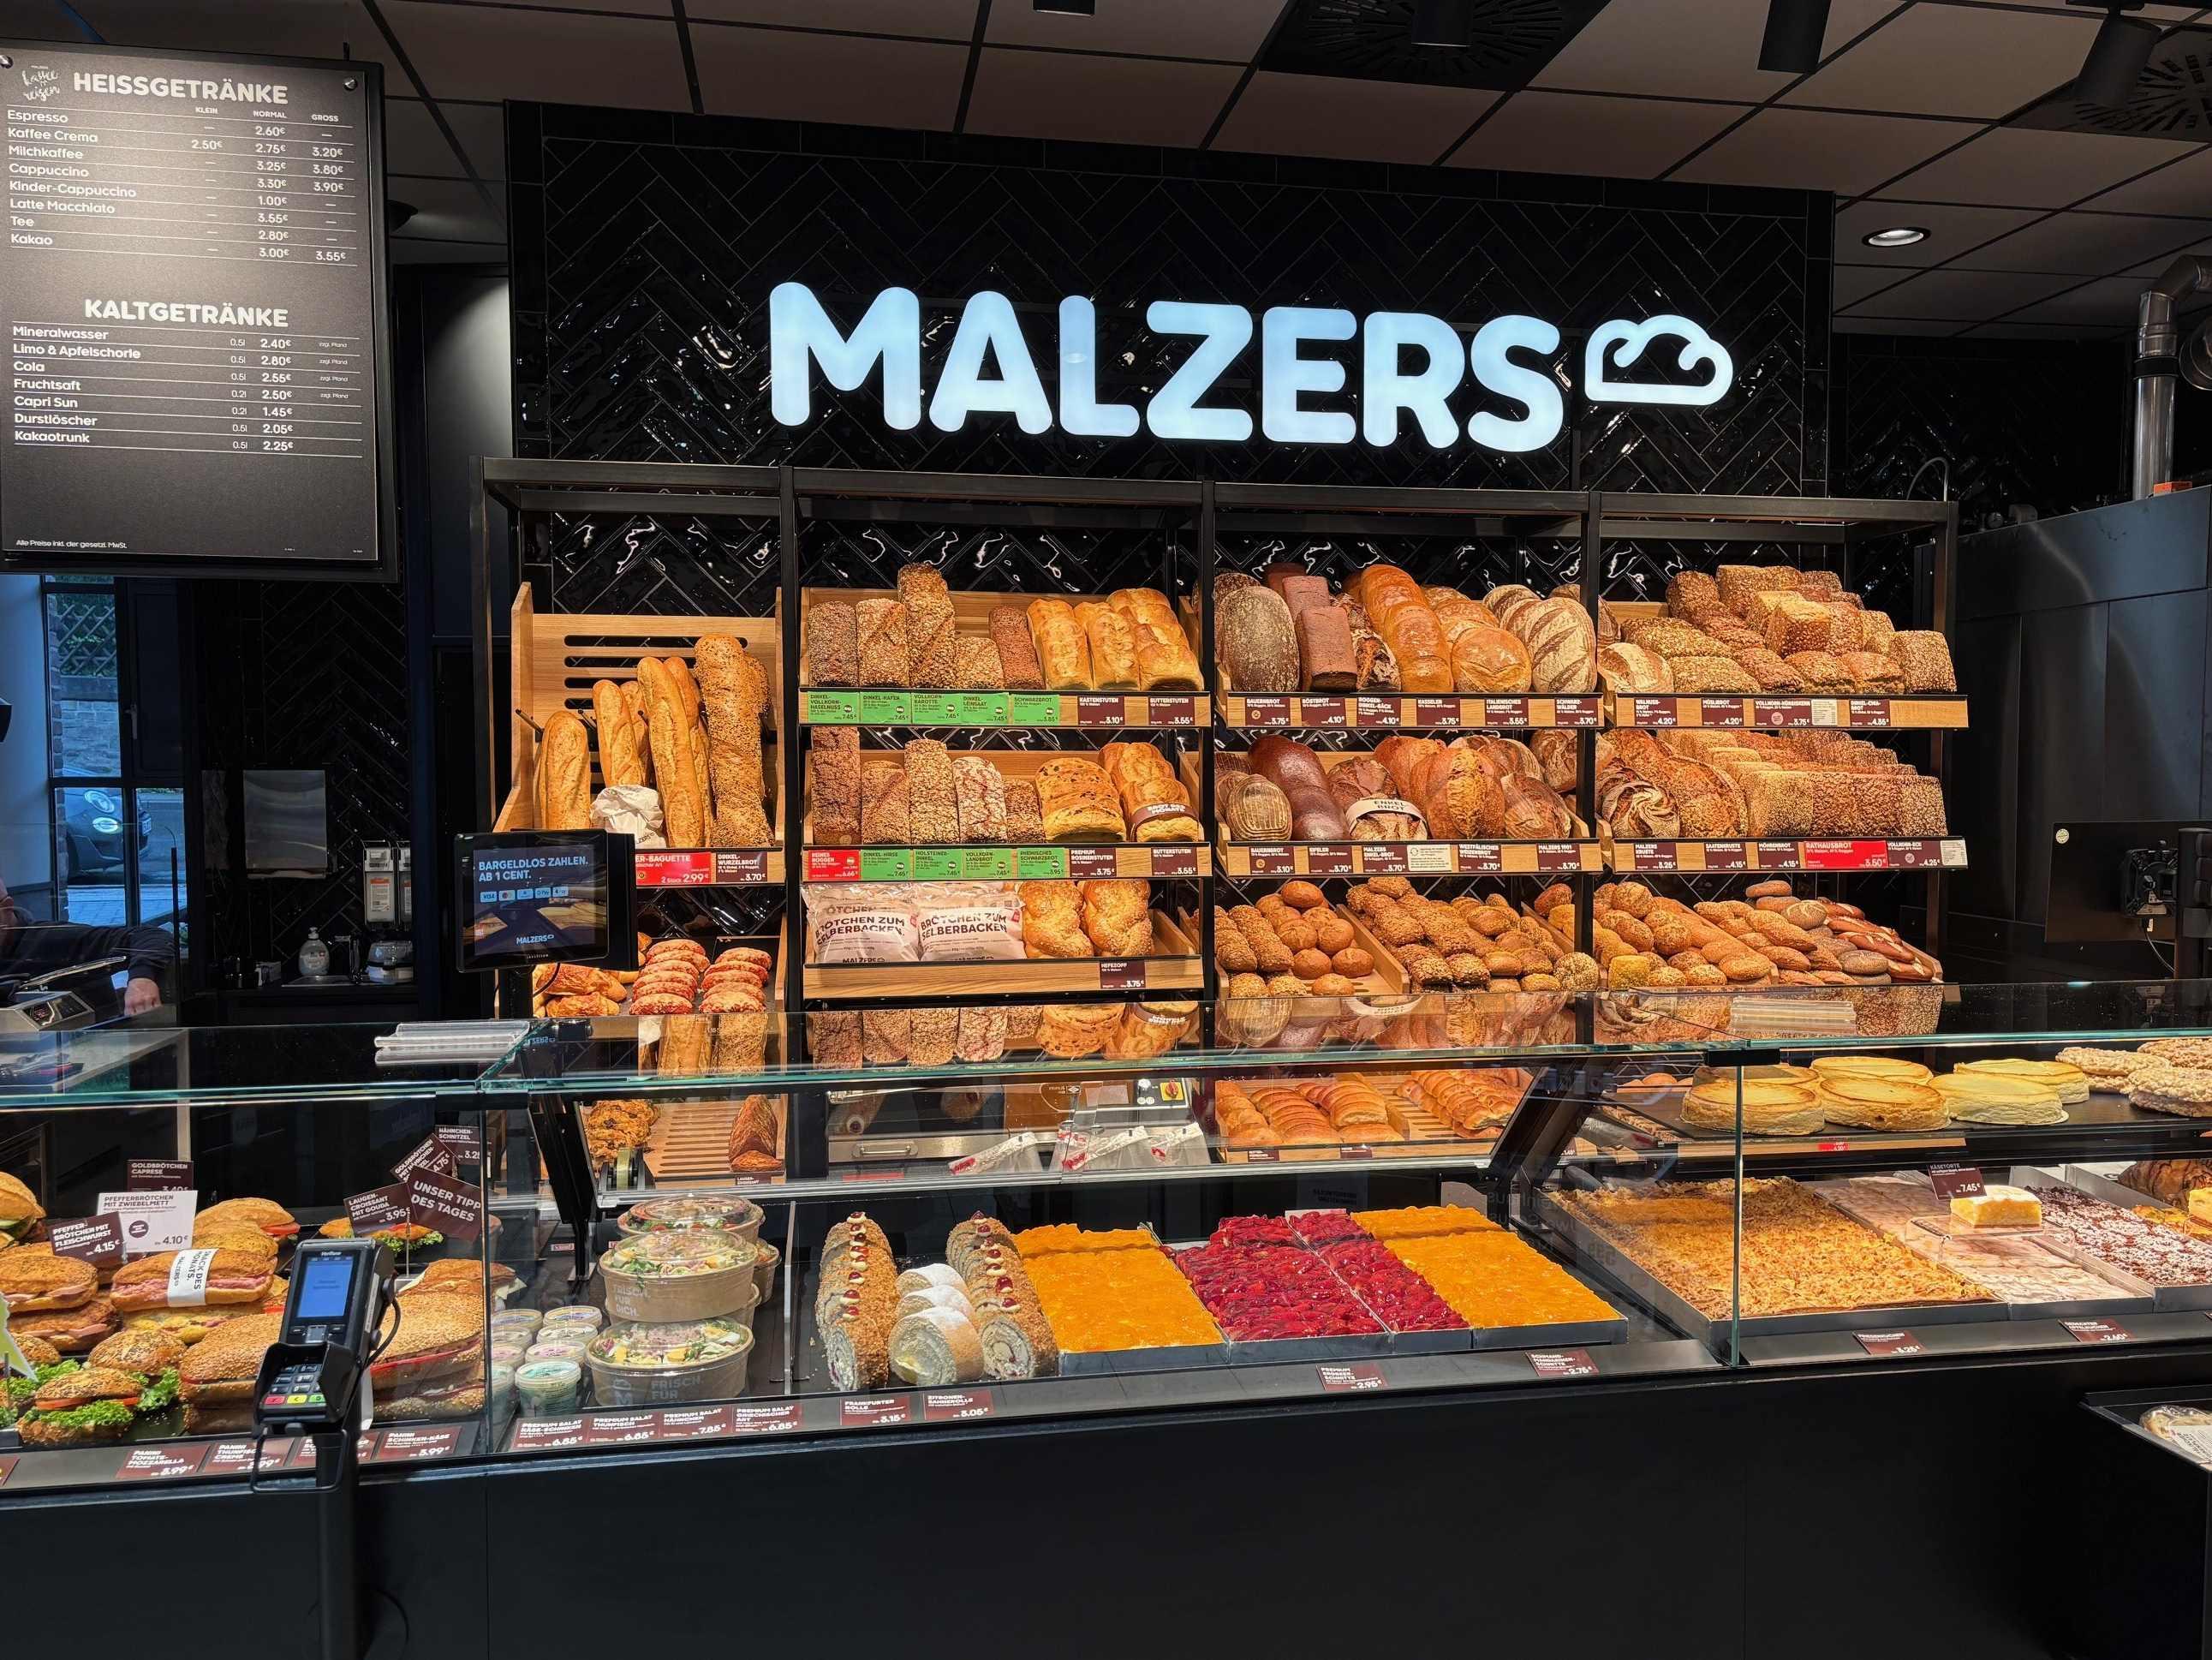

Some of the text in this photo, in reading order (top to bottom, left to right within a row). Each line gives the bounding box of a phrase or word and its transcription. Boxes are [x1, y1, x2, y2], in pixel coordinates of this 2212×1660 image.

[74, 72, 289, 104] HEISSGETRÄNKE
[8, 110, 285, 137] Espresso 2.60€
[8, 128, 343, 158] Kaffee Crema 2.50€ 2.75€ 3.20€
[9, 146, 343, 176] Milchkaffee 3.25€ 3.80€
[9, 163, 343, 193] Cappuccino 3.30€ 3.90€
[9, 181, 287, 206] Kinder-Cappuccino 1.00€
[10, 199, 288, 224] Latte Macchiato 3.55€
[11, 216, 289, 241] Tee 2.80€
[11, 233, 346, 261] Kakao 3.00€ 3.55€
[85, 299, 289, 327] KALTGETRÄNKE
[13, 326, 109, 339] Mineralwasser
[260, 338, 291, 349] 2.40€
[13, 344, 45, 355] Limo
[48, 345, 57, 355] &
[59, 345, 140, 361] Apfelschorle
[261, 355, 291, 366] 2.80€
[14, 361, 45, 373] Cola
[262, 373, 291, 383] 2.55€
[768, 281, 1565, 453] MALZERS
[14, 379, 81, 391] Fruchtsaft
[262, 390, 292, 400] 2.50€
[15, 396, 51, 409] Capri
[54, 397, 78, 408] Sun
[263, 407, 292, 417] 1.45€
[15, 413, 98, 427] Durstlöscher
[263, 424, 293, 434] 2.05€
[15, 430, 90, 444] Kakaotrunk
[264, 440, 293, 451] 2.25€
[479, 856, 588, 871] BARGELDLOS ZAHLEN.
[479, 870, 532, 881] AB 1 CENT.
[516, 935, 547, 945] MALZERS
[921, 923, 1007, 940] SELBERBACKEN
[414, 1180, 480, 1209] UNSER TIPP
[1960, 1183, 1980, 1192] 7.45€
[349, 1193, 378, 1205] LAUGEN-
[350, 1196, 388, 1211] CROISSANT
[366, 1203, 390, 1214] GOUDA
[411, 1194, 474, 1221] DES TAGES
[53, 1223, 87, 1234] PFEFFER-
[54, 1226, 94, 1241] BRÖTCHEN
[55, 1229, 111, 1248] FLEISCHWURST
[93, 1239, 121, 1254] 4.15€
[163, 1235, 188, 1245] 4.10€
[194, 1273, 203, 1289] DES
